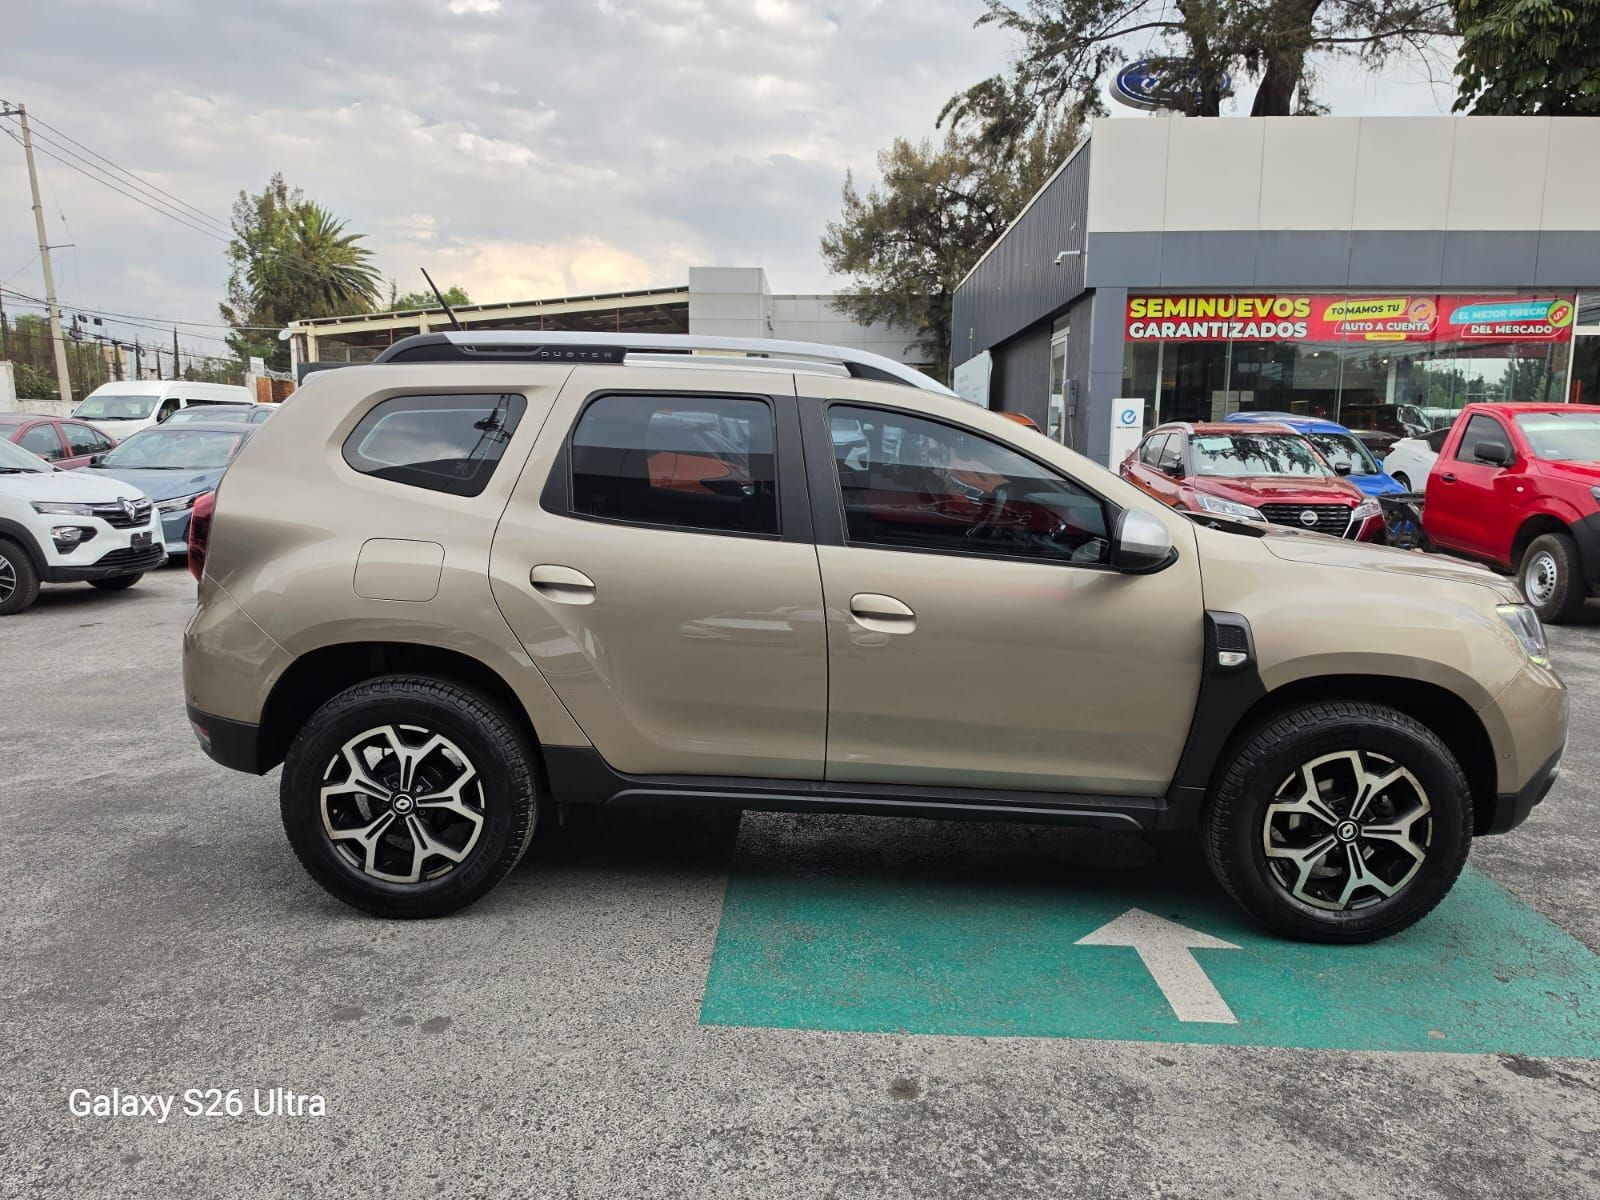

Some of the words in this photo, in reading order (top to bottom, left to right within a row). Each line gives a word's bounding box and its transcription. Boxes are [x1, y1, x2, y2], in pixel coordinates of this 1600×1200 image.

[1129, 298, 1311, 319] SEMINUEVOS
[1331, 304, 1384, 315] TOMAMOS
[1387, 304, 1400, 312] TU
[1458, 312, 1469, 320] EL
[1471, 309, 1507, 319] MEJOR
[1509, 306, 1547, 317] PRECIO
[1129, 321, 1308, 339] GARANTIZADOS
[1341, 322, 1373, 331] AUTO
[1375, 322, 1384, 331] A
[1386, 322, 1430, 331] CUENTA
[1471, 325, 1493, 334] DEL
[1495, 325, 1553, 334] MERCADO
[541, 351, 613, 359] DUSTER
